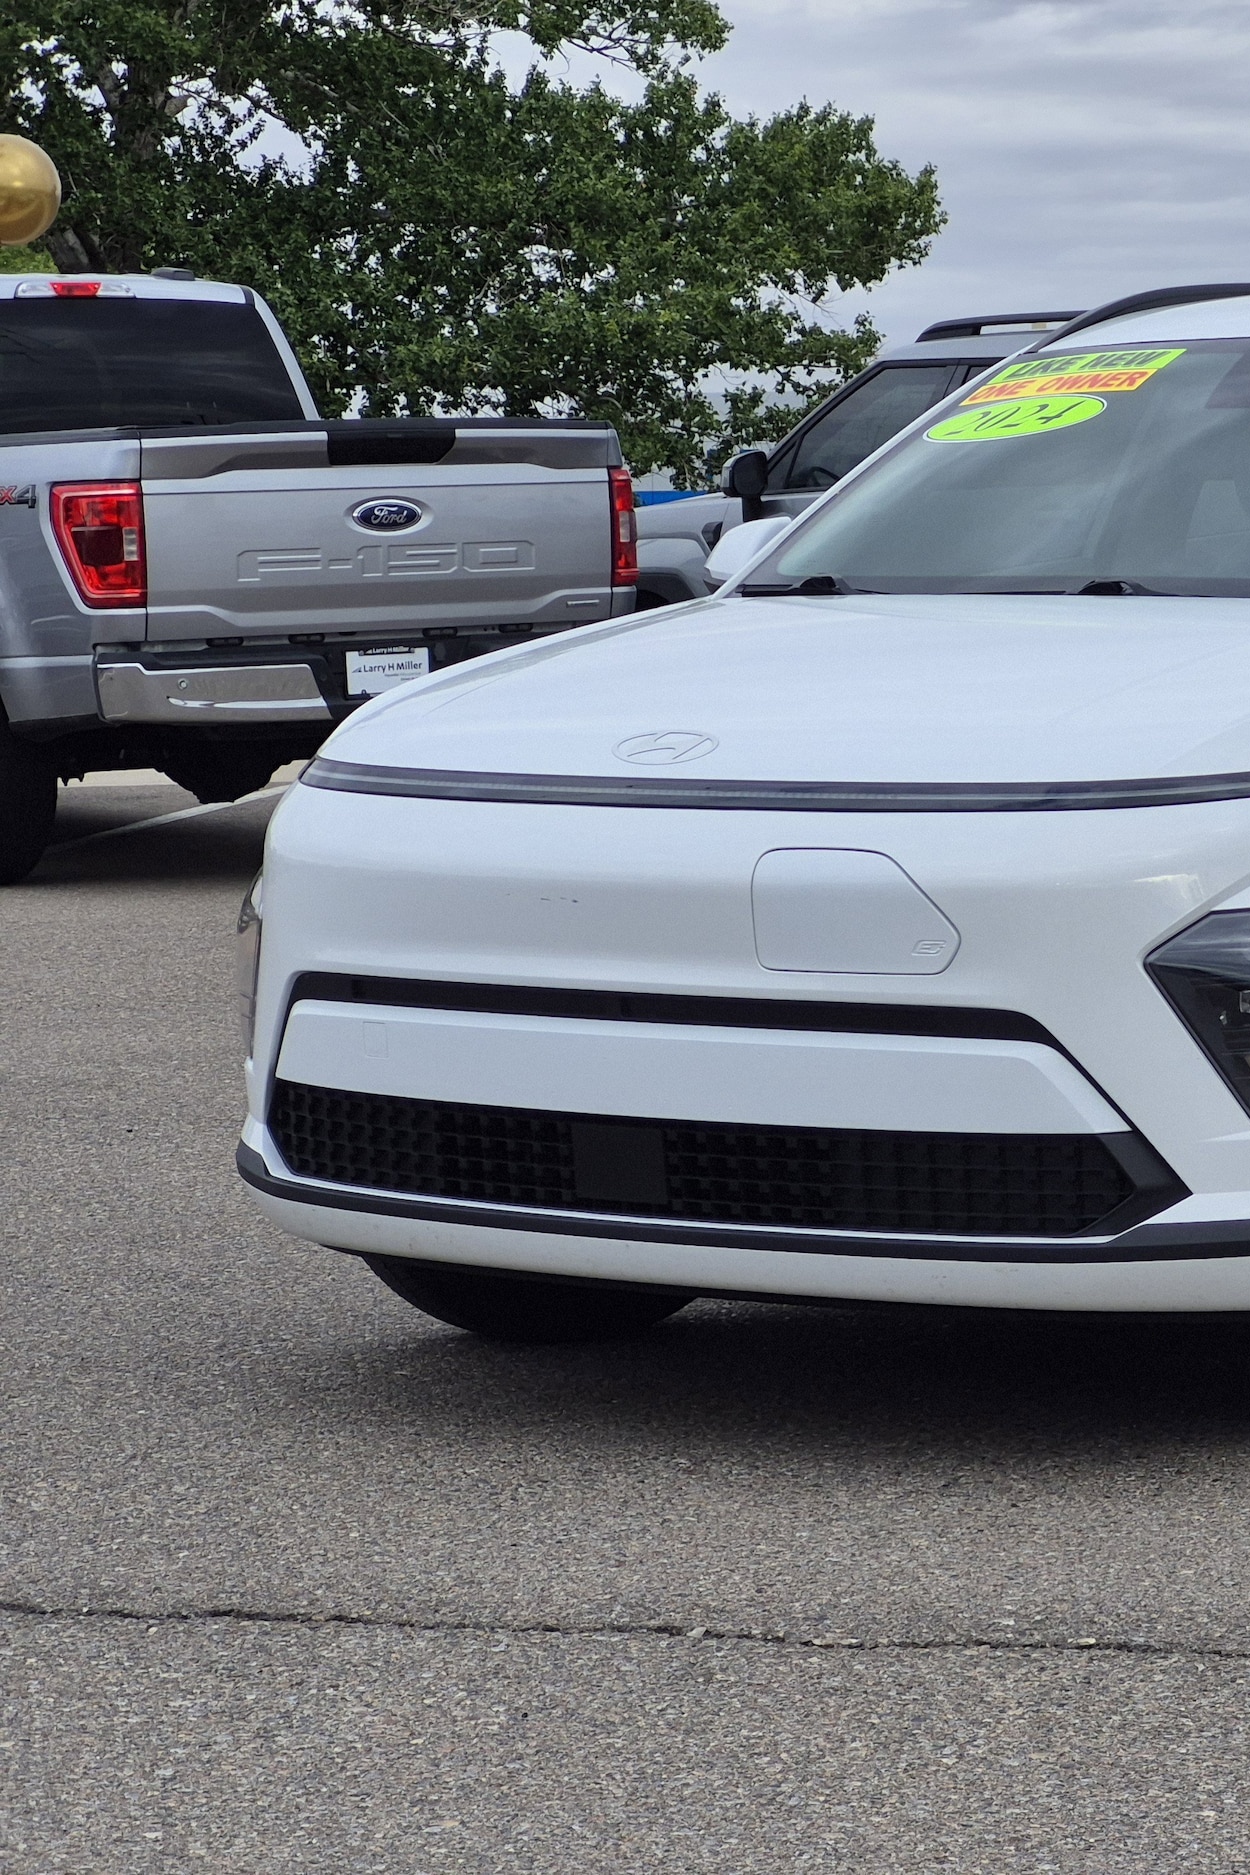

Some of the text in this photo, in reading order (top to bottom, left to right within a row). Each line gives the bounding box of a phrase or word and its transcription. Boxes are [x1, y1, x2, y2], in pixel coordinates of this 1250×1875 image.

[1005, 350, 1171, 380] LIKE NEW
[968, 371, 1148, 402] ONE OWNER
[942, 400, 1087, 436] 2024
[371, 506, 408, 524] Ford
[237, 540, 535, 582] F-150
[372, 647, 387, 655] Larry
[363, 661, 422, 673] Larry H Miller
